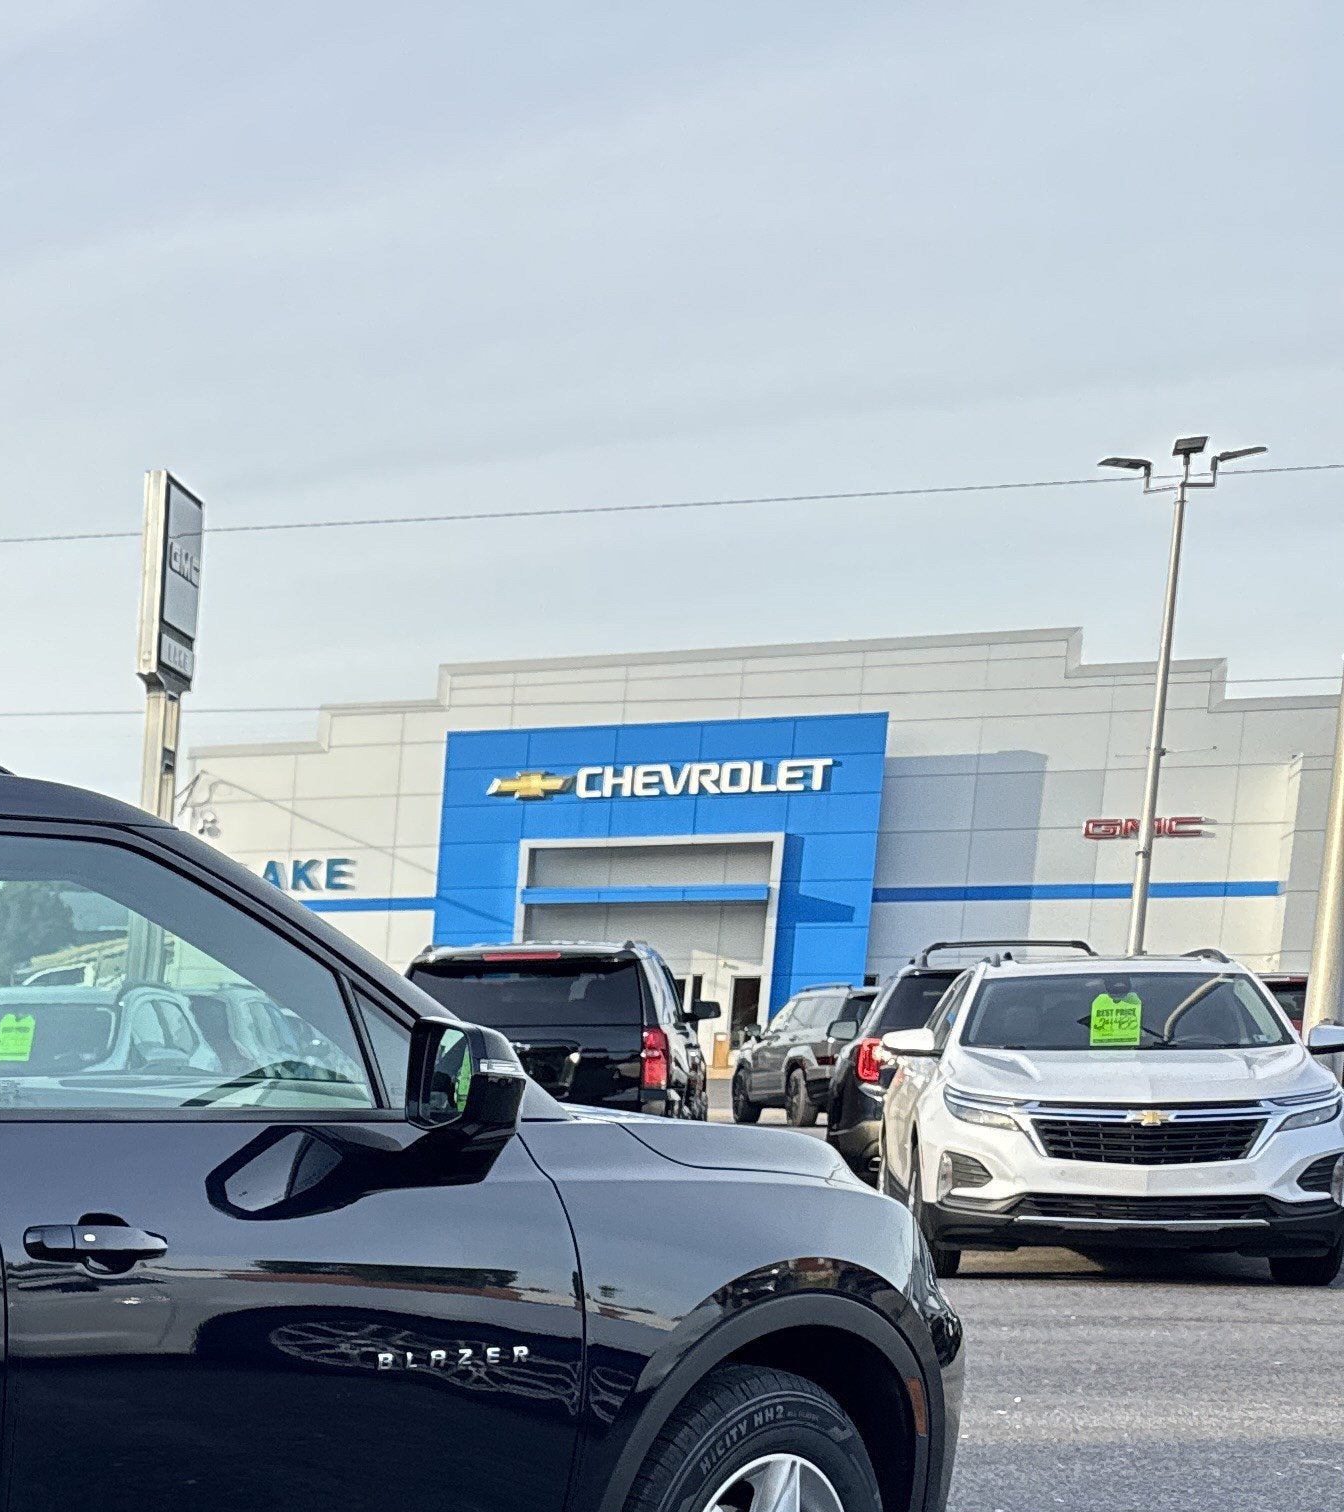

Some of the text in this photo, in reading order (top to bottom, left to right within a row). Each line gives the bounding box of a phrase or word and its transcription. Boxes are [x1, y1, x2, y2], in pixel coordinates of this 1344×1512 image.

[576, 758, 834, 798] CHEVROLET
[1082, 816, 1202, 839] GMC
[262, 858, 353, 890] AKE
[1096, 1008, 1137, 1017] BEST PRICE
[377, 1345, 529, 1371] BLAZER
[700, 1419, 748, 1475] HICITY
[753, 1405, 785, 1427] HH2
